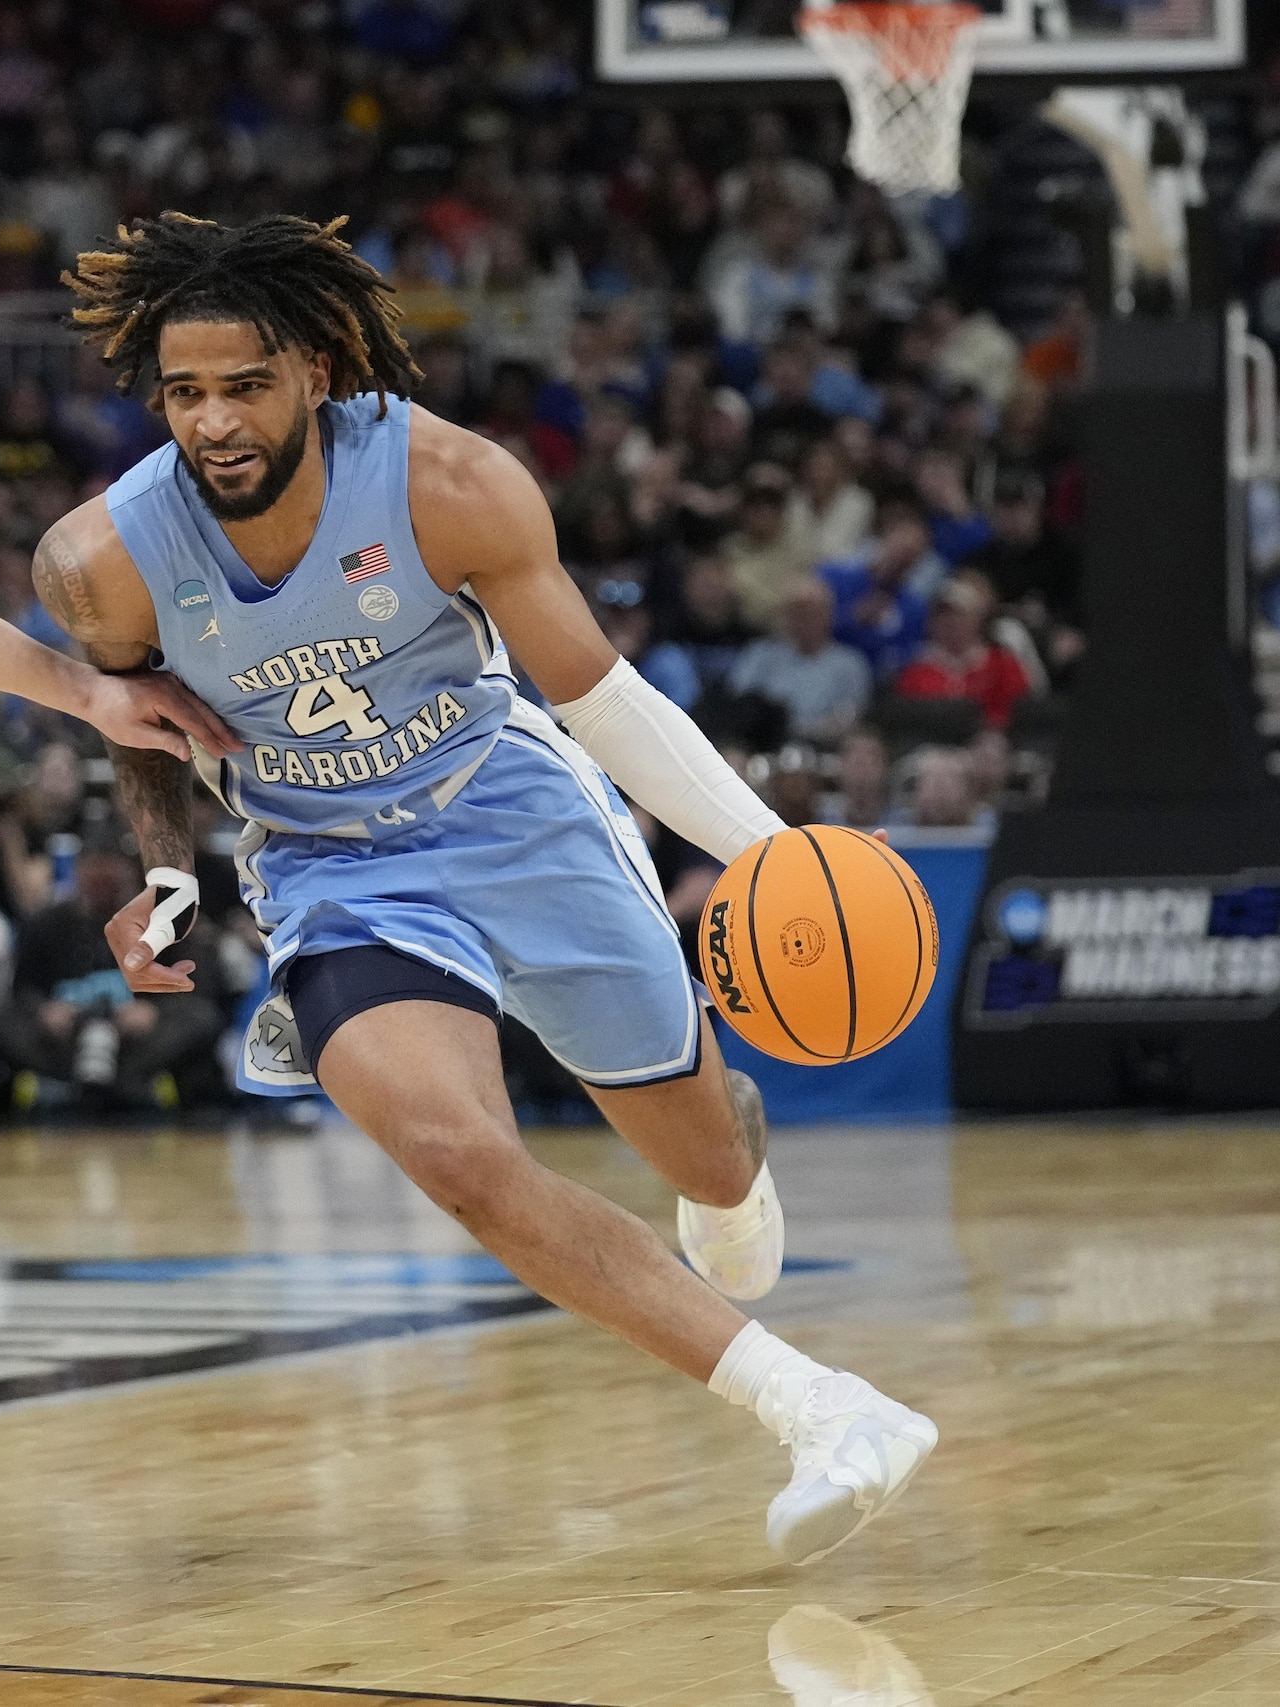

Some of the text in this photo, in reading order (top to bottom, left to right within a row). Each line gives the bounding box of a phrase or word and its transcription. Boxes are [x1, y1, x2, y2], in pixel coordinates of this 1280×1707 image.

[179, 593, 210, 609] NCAA
[366, 594, 394, 610] ACC
[229, 636, 386, 693] NORTH
[285, 673, 391, 741] 4
[253, 691, 468, 788] CAROLINA
[729, 899, 737, 930] BALL
[1048, 889, 1213, 941] MARCH
[709, 899, 752, 1014] NCAA
[729, 931, 738, 966] GAME
